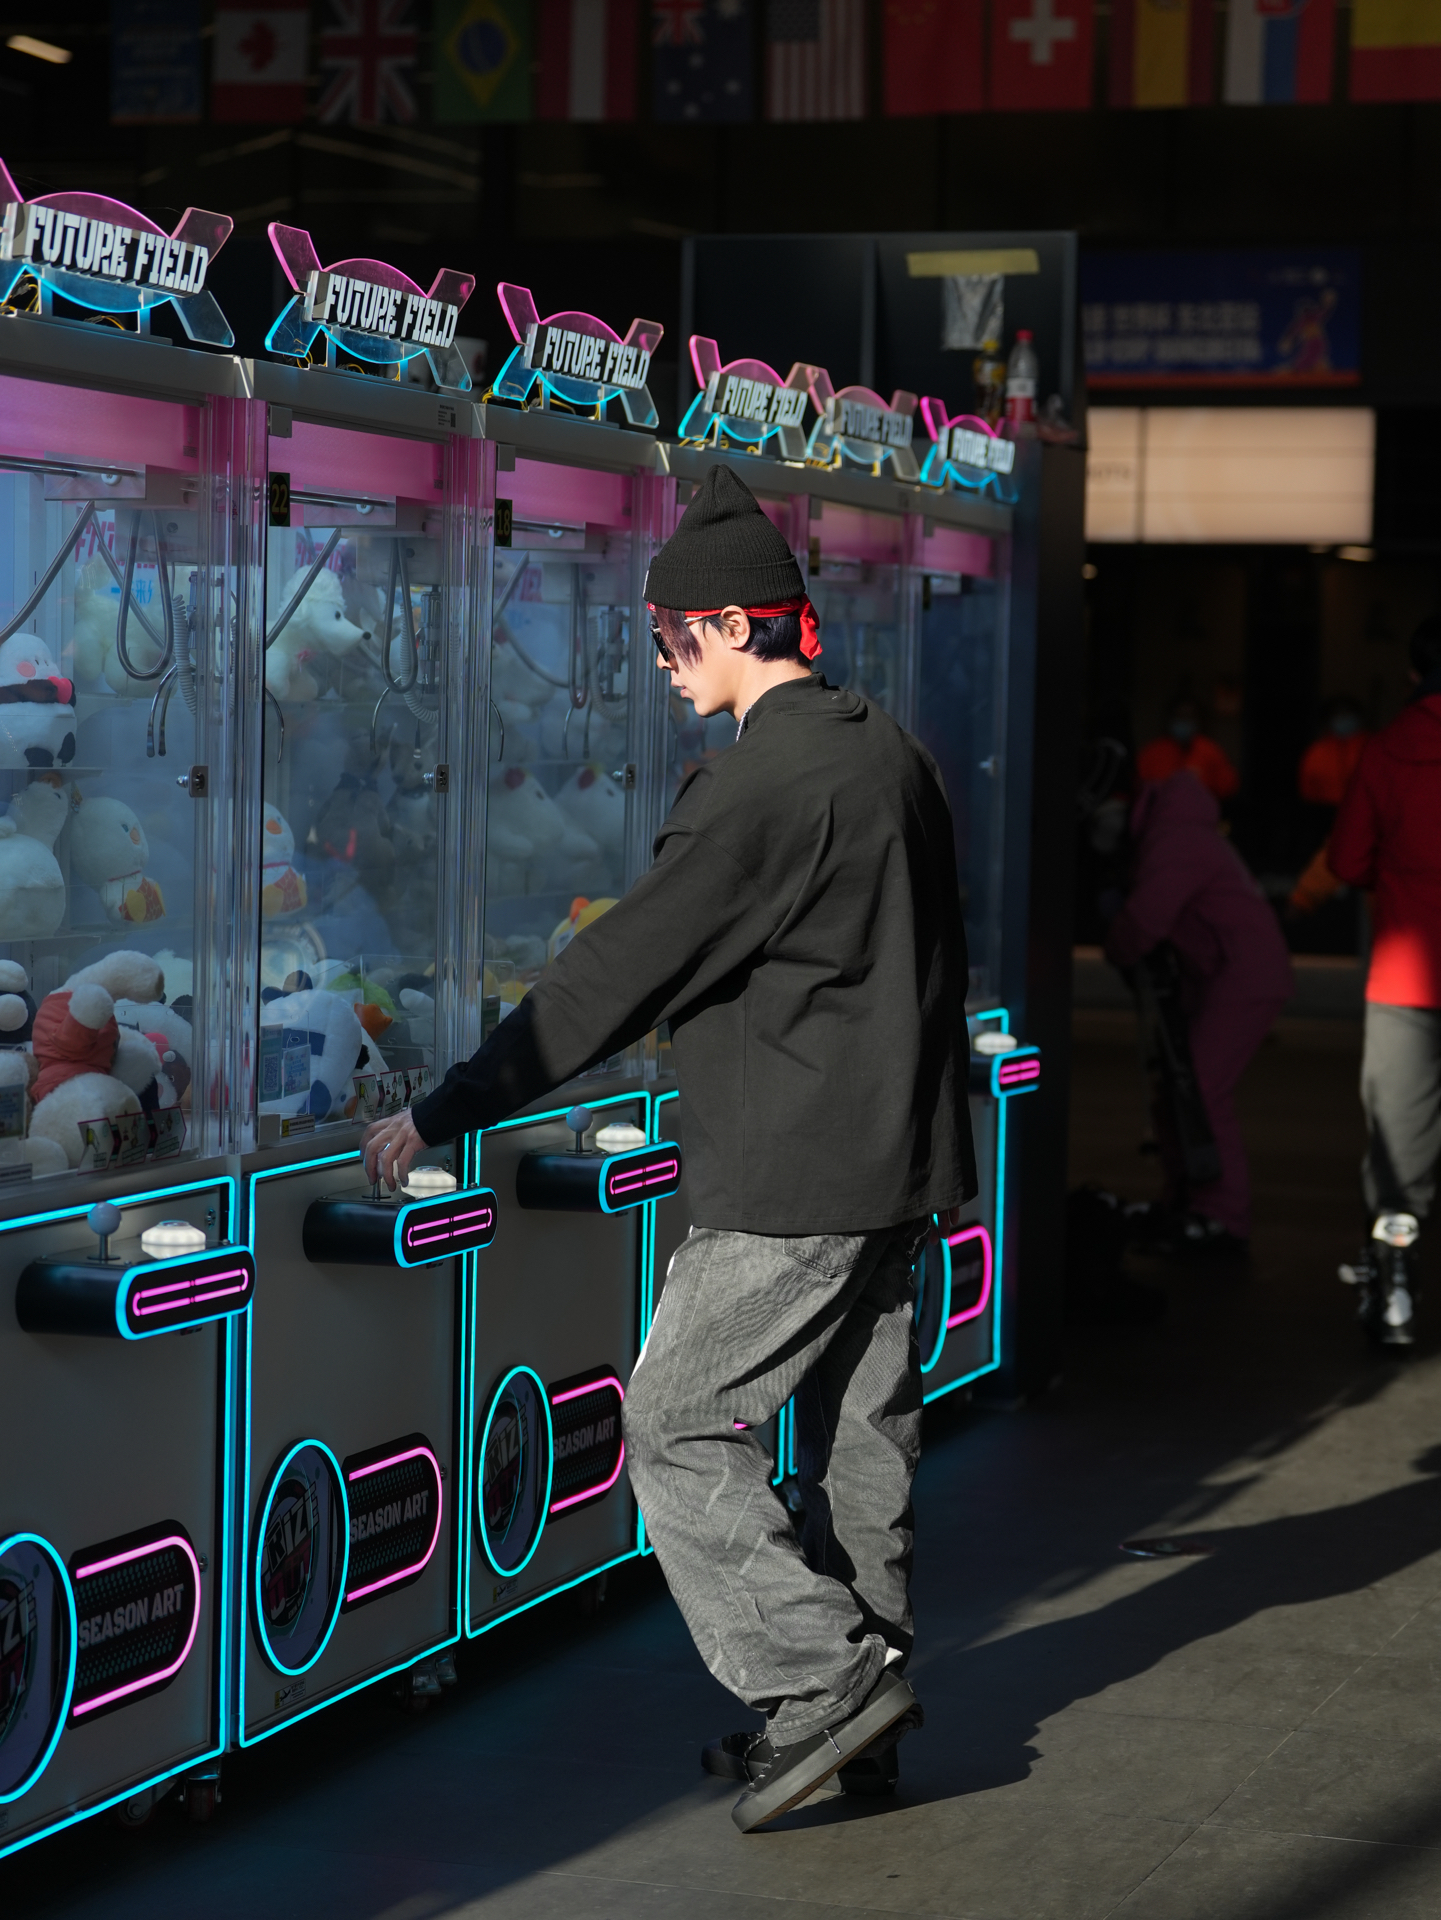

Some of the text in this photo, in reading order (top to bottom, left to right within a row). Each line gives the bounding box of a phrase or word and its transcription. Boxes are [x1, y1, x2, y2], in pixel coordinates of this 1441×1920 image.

[25, 204, 209, 294] FUTURE FIELD
[323, 273, 459, 349] FUTURE FIELD
[541, 325, 651, 390] FUTURE FIELD
[720, 374, 808, 428] FUTURE FIELD
[271, 483, 288, 515] 22
[497, 508, 511, 537] 18
[552, 1415, 616, 1460] SEASON ART
[349, 1489, 429, 1545] SEASON ART
[78, 1583, 185, 1650] SEASON ART
